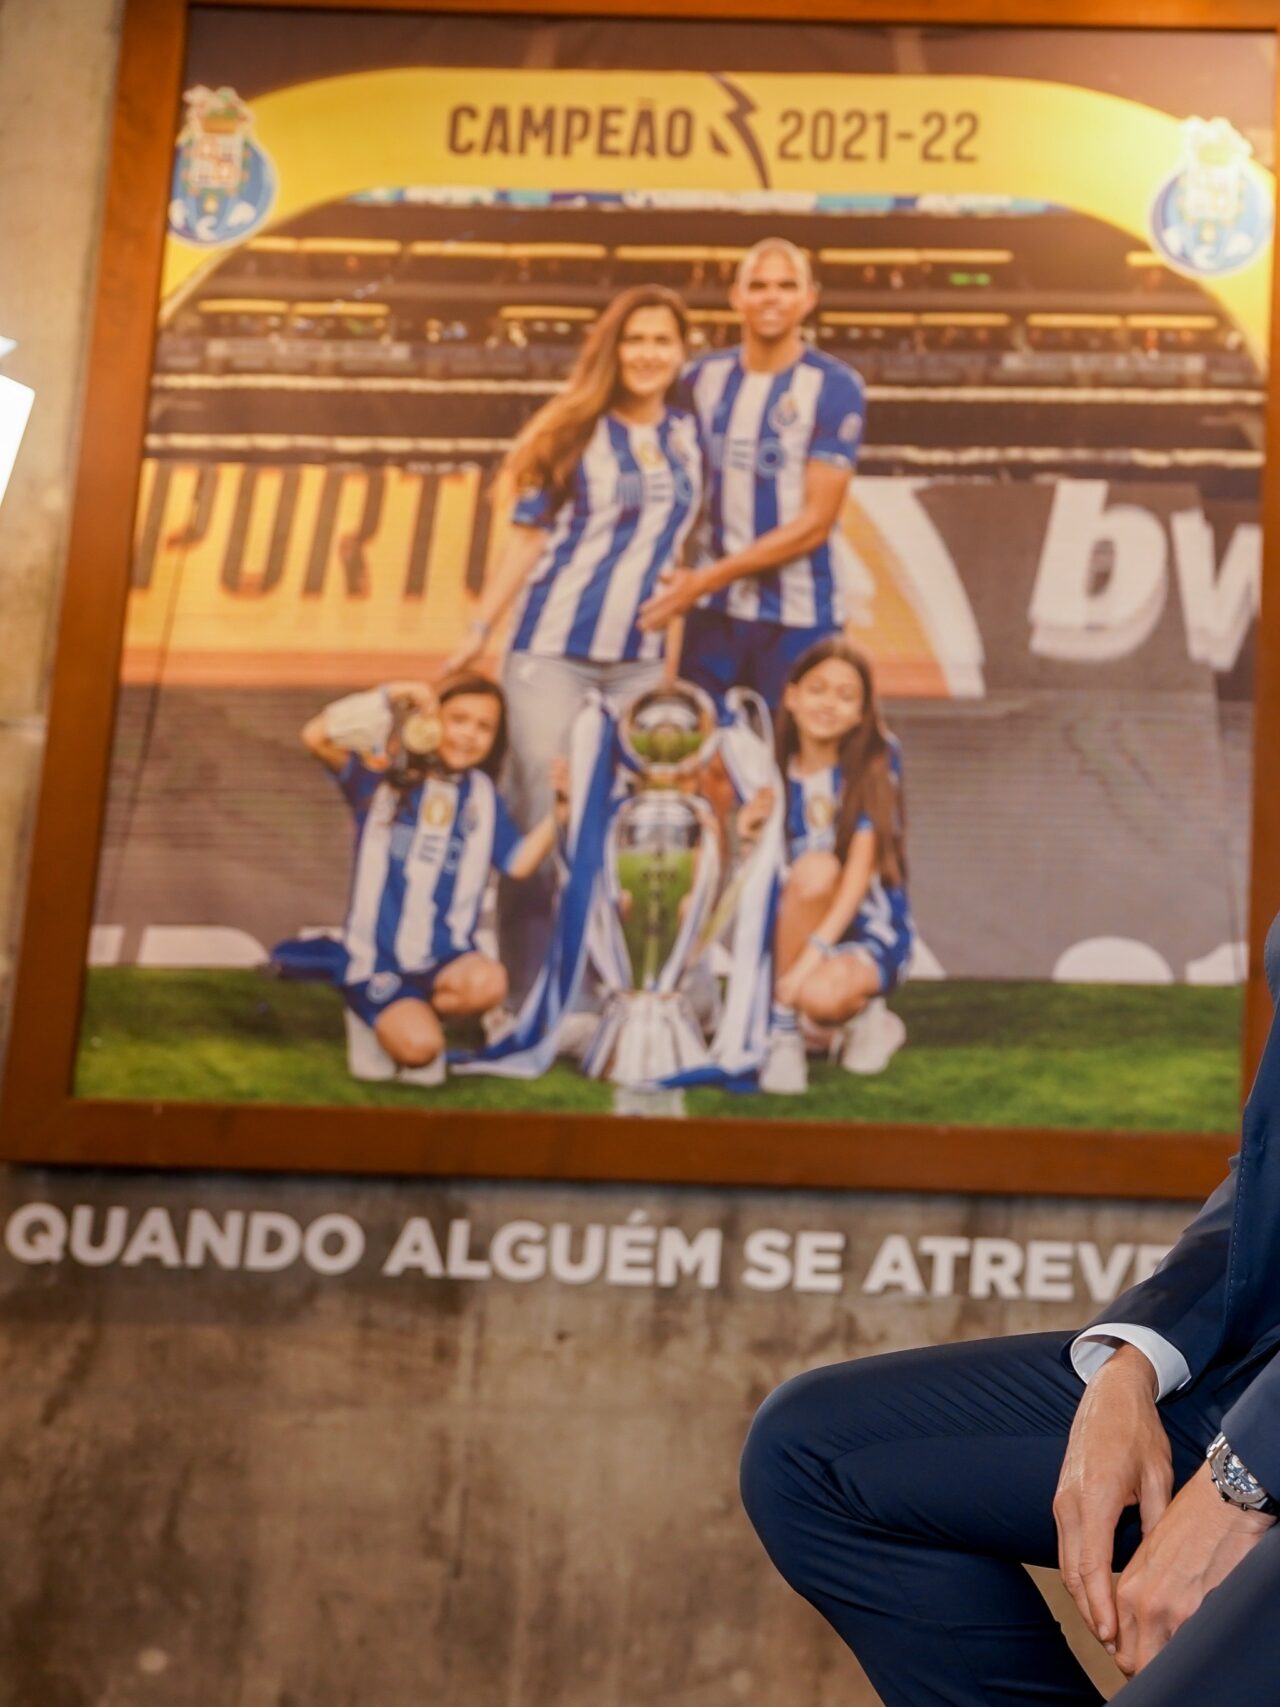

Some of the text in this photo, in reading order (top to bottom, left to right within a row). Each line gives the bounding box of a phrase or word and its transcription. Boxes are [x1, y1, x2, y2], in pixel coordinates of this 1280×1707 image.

[447, 98, 980, 164] CAMPEÃO 2021-22
[4, 1202, 366, 1276] QUANDO
[381, 1209, 723, 1289] ALGUÉM
[740, 1228, 846, 1293] SE
